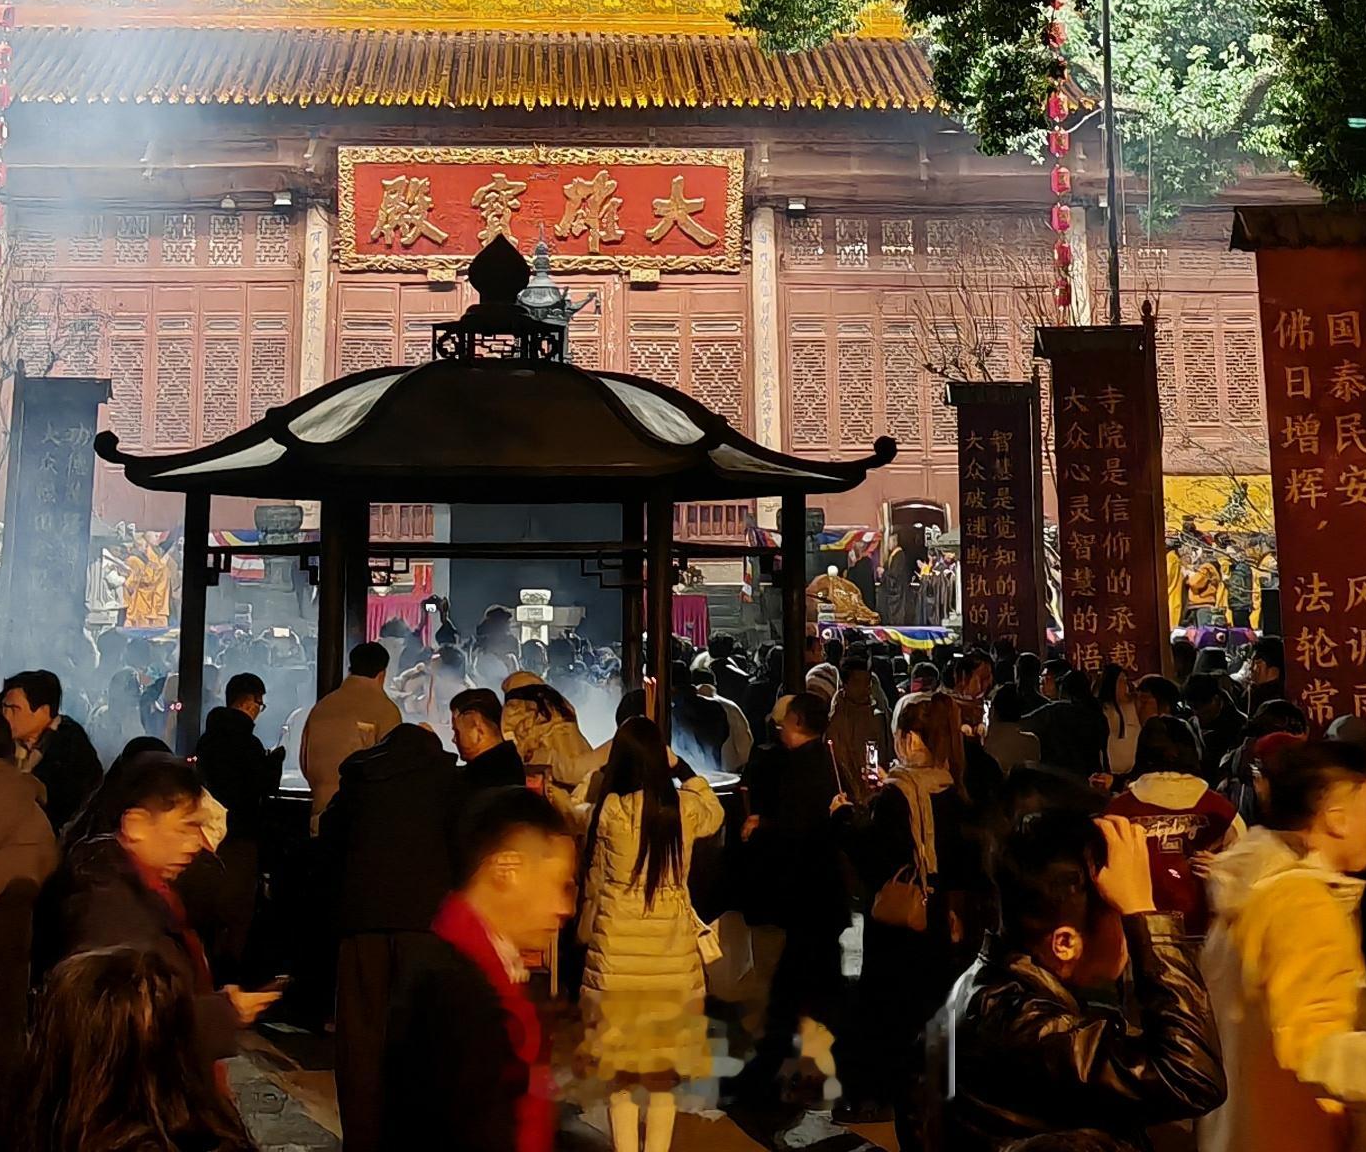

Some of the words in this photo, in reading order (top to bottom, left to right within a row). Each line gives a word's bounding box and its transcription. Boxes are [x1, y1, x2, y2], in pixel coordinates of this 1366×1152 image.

[1274, 311, 1330, 530] 佛日增辉，
[963, 430, 990, 641] 大众破迷断执的
[1295, 576, 1340, 725] 法轮常
